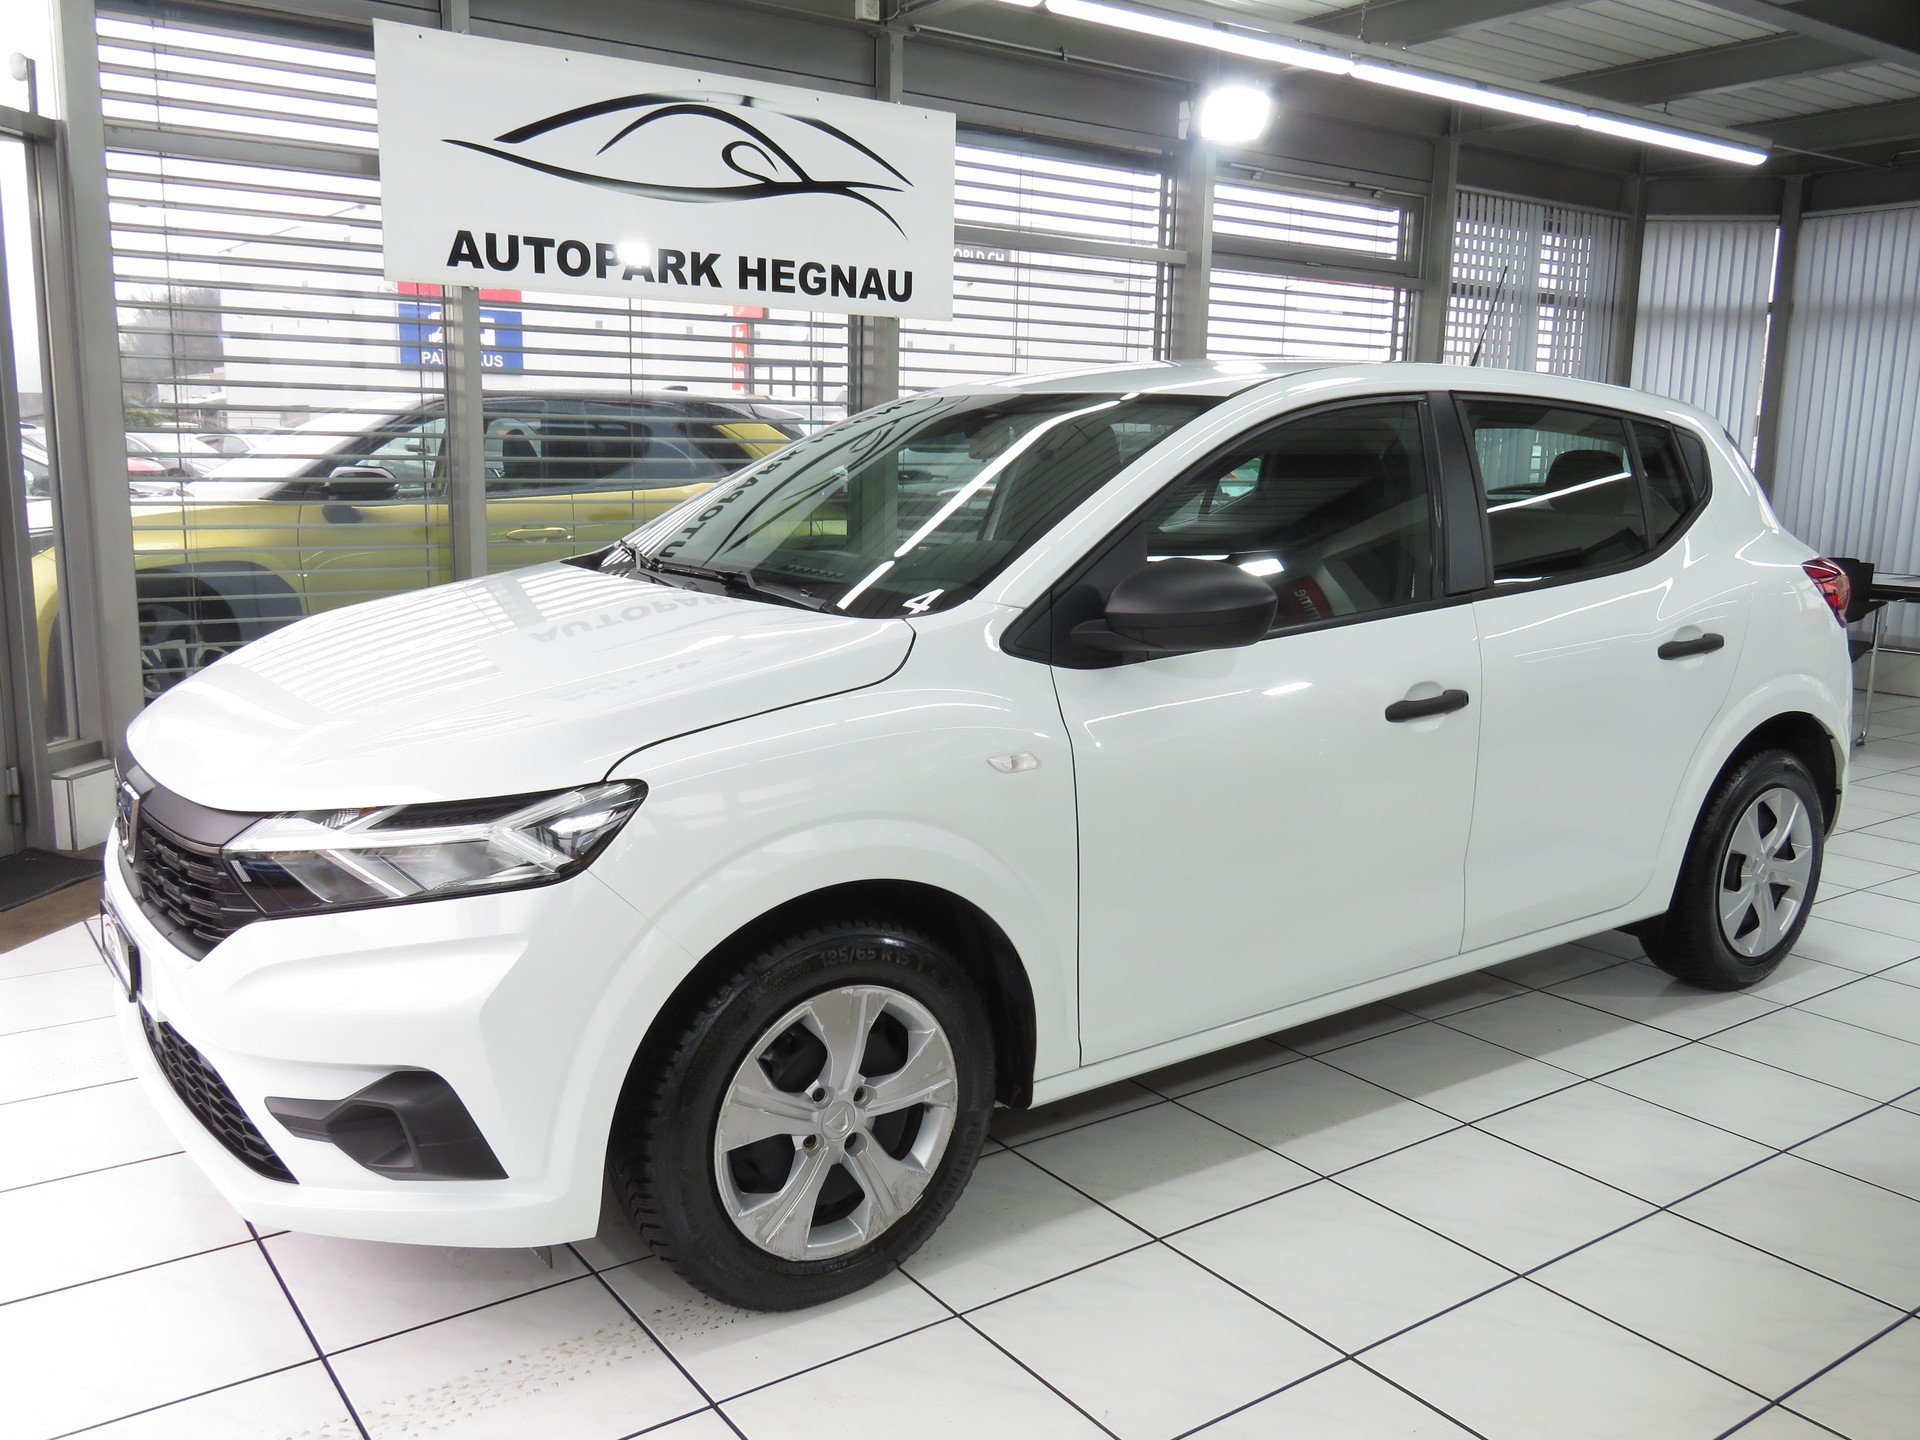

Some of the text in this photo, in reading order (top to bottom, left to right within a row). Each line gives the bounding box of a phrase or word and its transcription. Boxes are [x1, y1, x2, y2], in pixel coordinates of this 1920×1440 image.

[447, 230, 913, 303] AUTOPARK HEGNAU
[820, 945, 877, 969] 185/65
